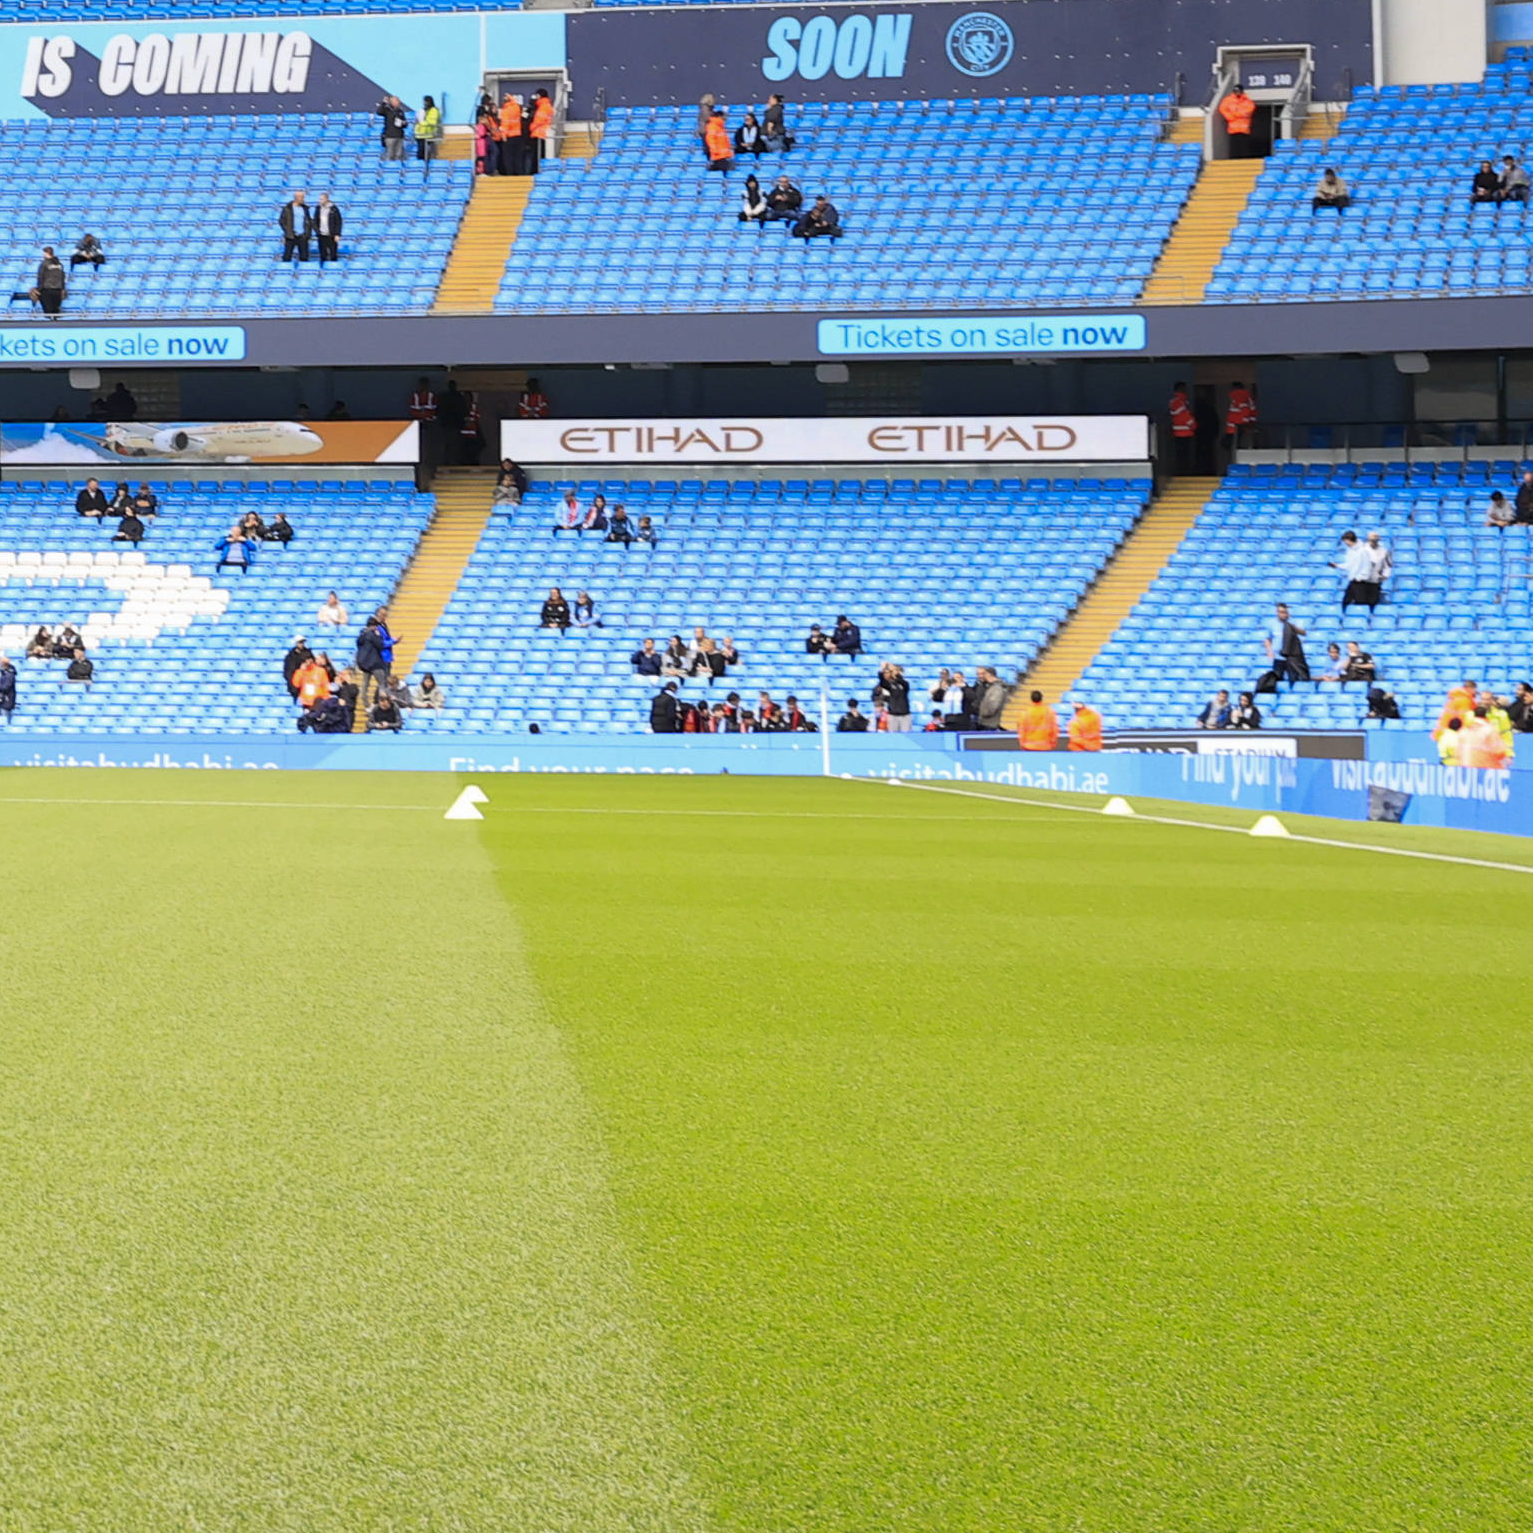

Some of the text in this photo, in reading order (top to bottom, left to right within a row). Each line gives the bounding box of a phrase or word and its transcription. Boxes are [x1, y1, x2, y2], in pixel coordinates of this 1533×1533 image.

[762, 14, 913, 81] SOON
[20, 31, 312, 98] IS COMING
[64, 339, 96, 356] on
[103, 334, 159, 356] sale
[167, 338, 230, 356] now
[836, 324, 1128, 349] Tickets on sale now
[559, 424, 1077, 453] ETIHAD ETIHAD
